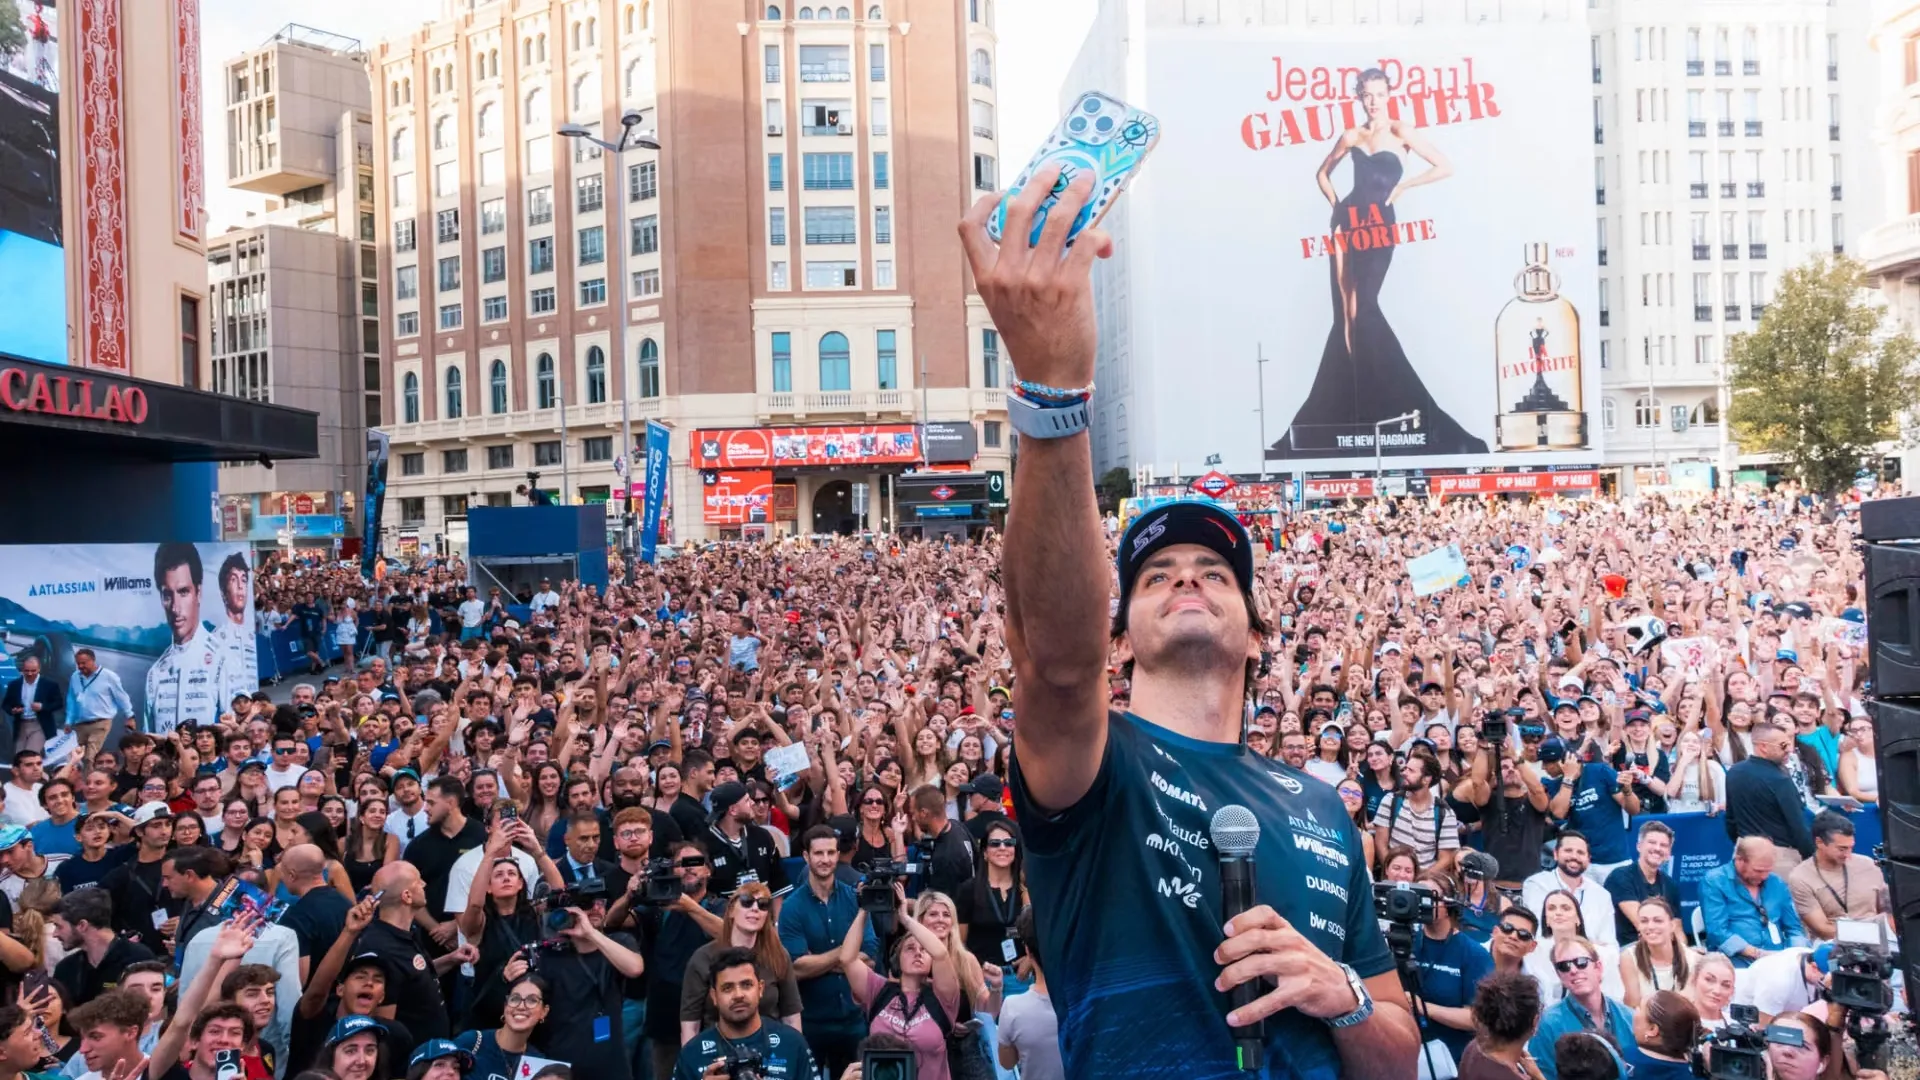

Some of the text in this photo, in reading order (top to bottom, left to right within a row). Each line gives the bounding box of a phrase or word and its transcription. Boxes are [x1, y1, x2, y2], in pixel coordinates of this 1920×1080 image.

[1266, 57, 1477, 101] Jean Paul
[1348, 203, 1384, 227] LA
[1300, 219, 1437, 259] FAVORITE
[1555, 247, 1575, 258] NEW
[1529, 344, 1548, 360] LA
[1502, 355, 1577, 379] FAVORITE
[0, 367, 148, 424] CALLAO
[1336, 433, 1426, 447] THE NEW RAGRANCE
[1205, 481, 1225, 489] Metro
[1440, 478, 1481, 489] POP MART
[1497, 476, 1537, 488] POP MART
[1552, 474, 1592, 486] POP MART
[1320, 482, 1359, 494] GUYS
[38, 581, 95, 596] ATLASSIAN
[103, 577, 151, 591] Williams
[1166, 817, 1209, 850] laude
[1288, 815, 1344, 842] ATLASSIAN
[1293, 833, 1349, 866] Williams
